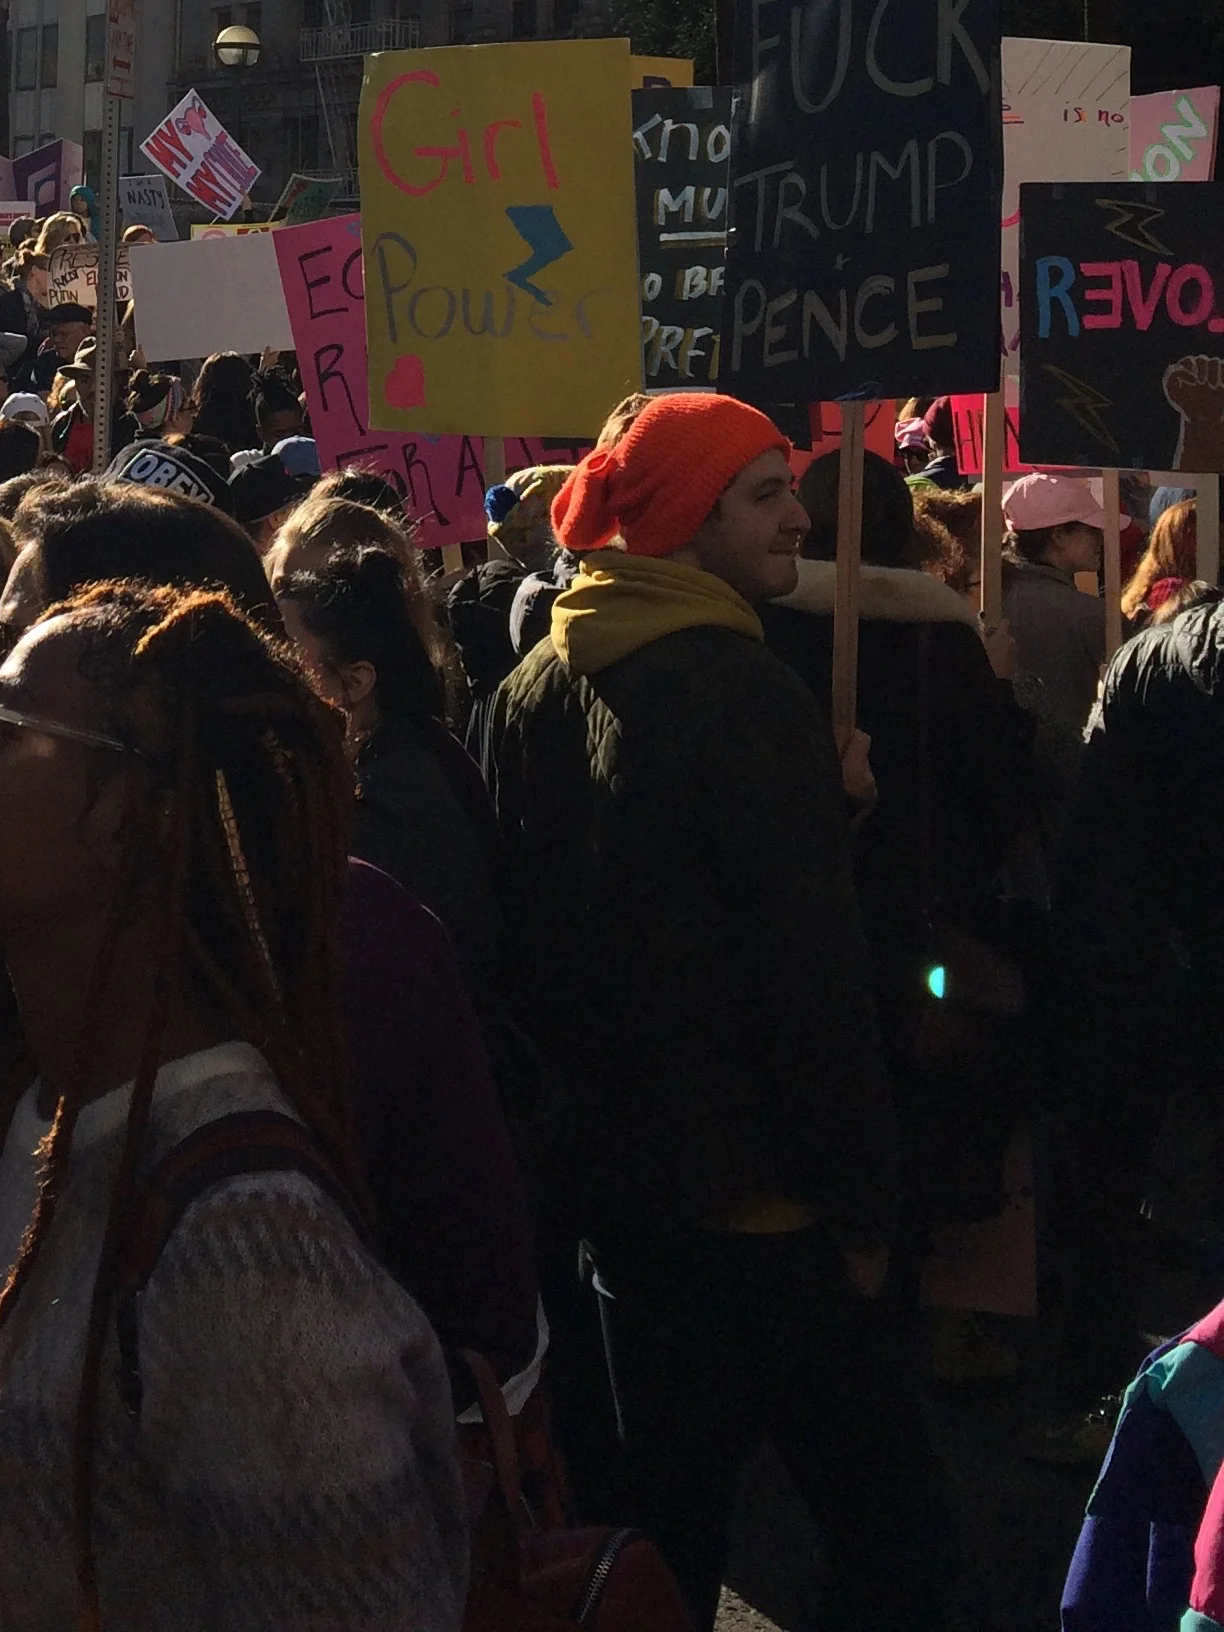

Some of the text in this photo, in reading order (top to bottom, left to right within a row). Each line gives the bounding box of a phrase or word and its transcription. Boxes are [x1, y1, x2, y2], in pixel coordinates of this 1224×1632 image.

[144, 119, 194, 179] MY
[371, 70, 559, 196] Girl
[127, 189, 165, 209] NASTY
[734, 130, 974, 252] TRUMP
[373, 231, 614, 345] Power
[731, 263, 958, 371] PENCE
